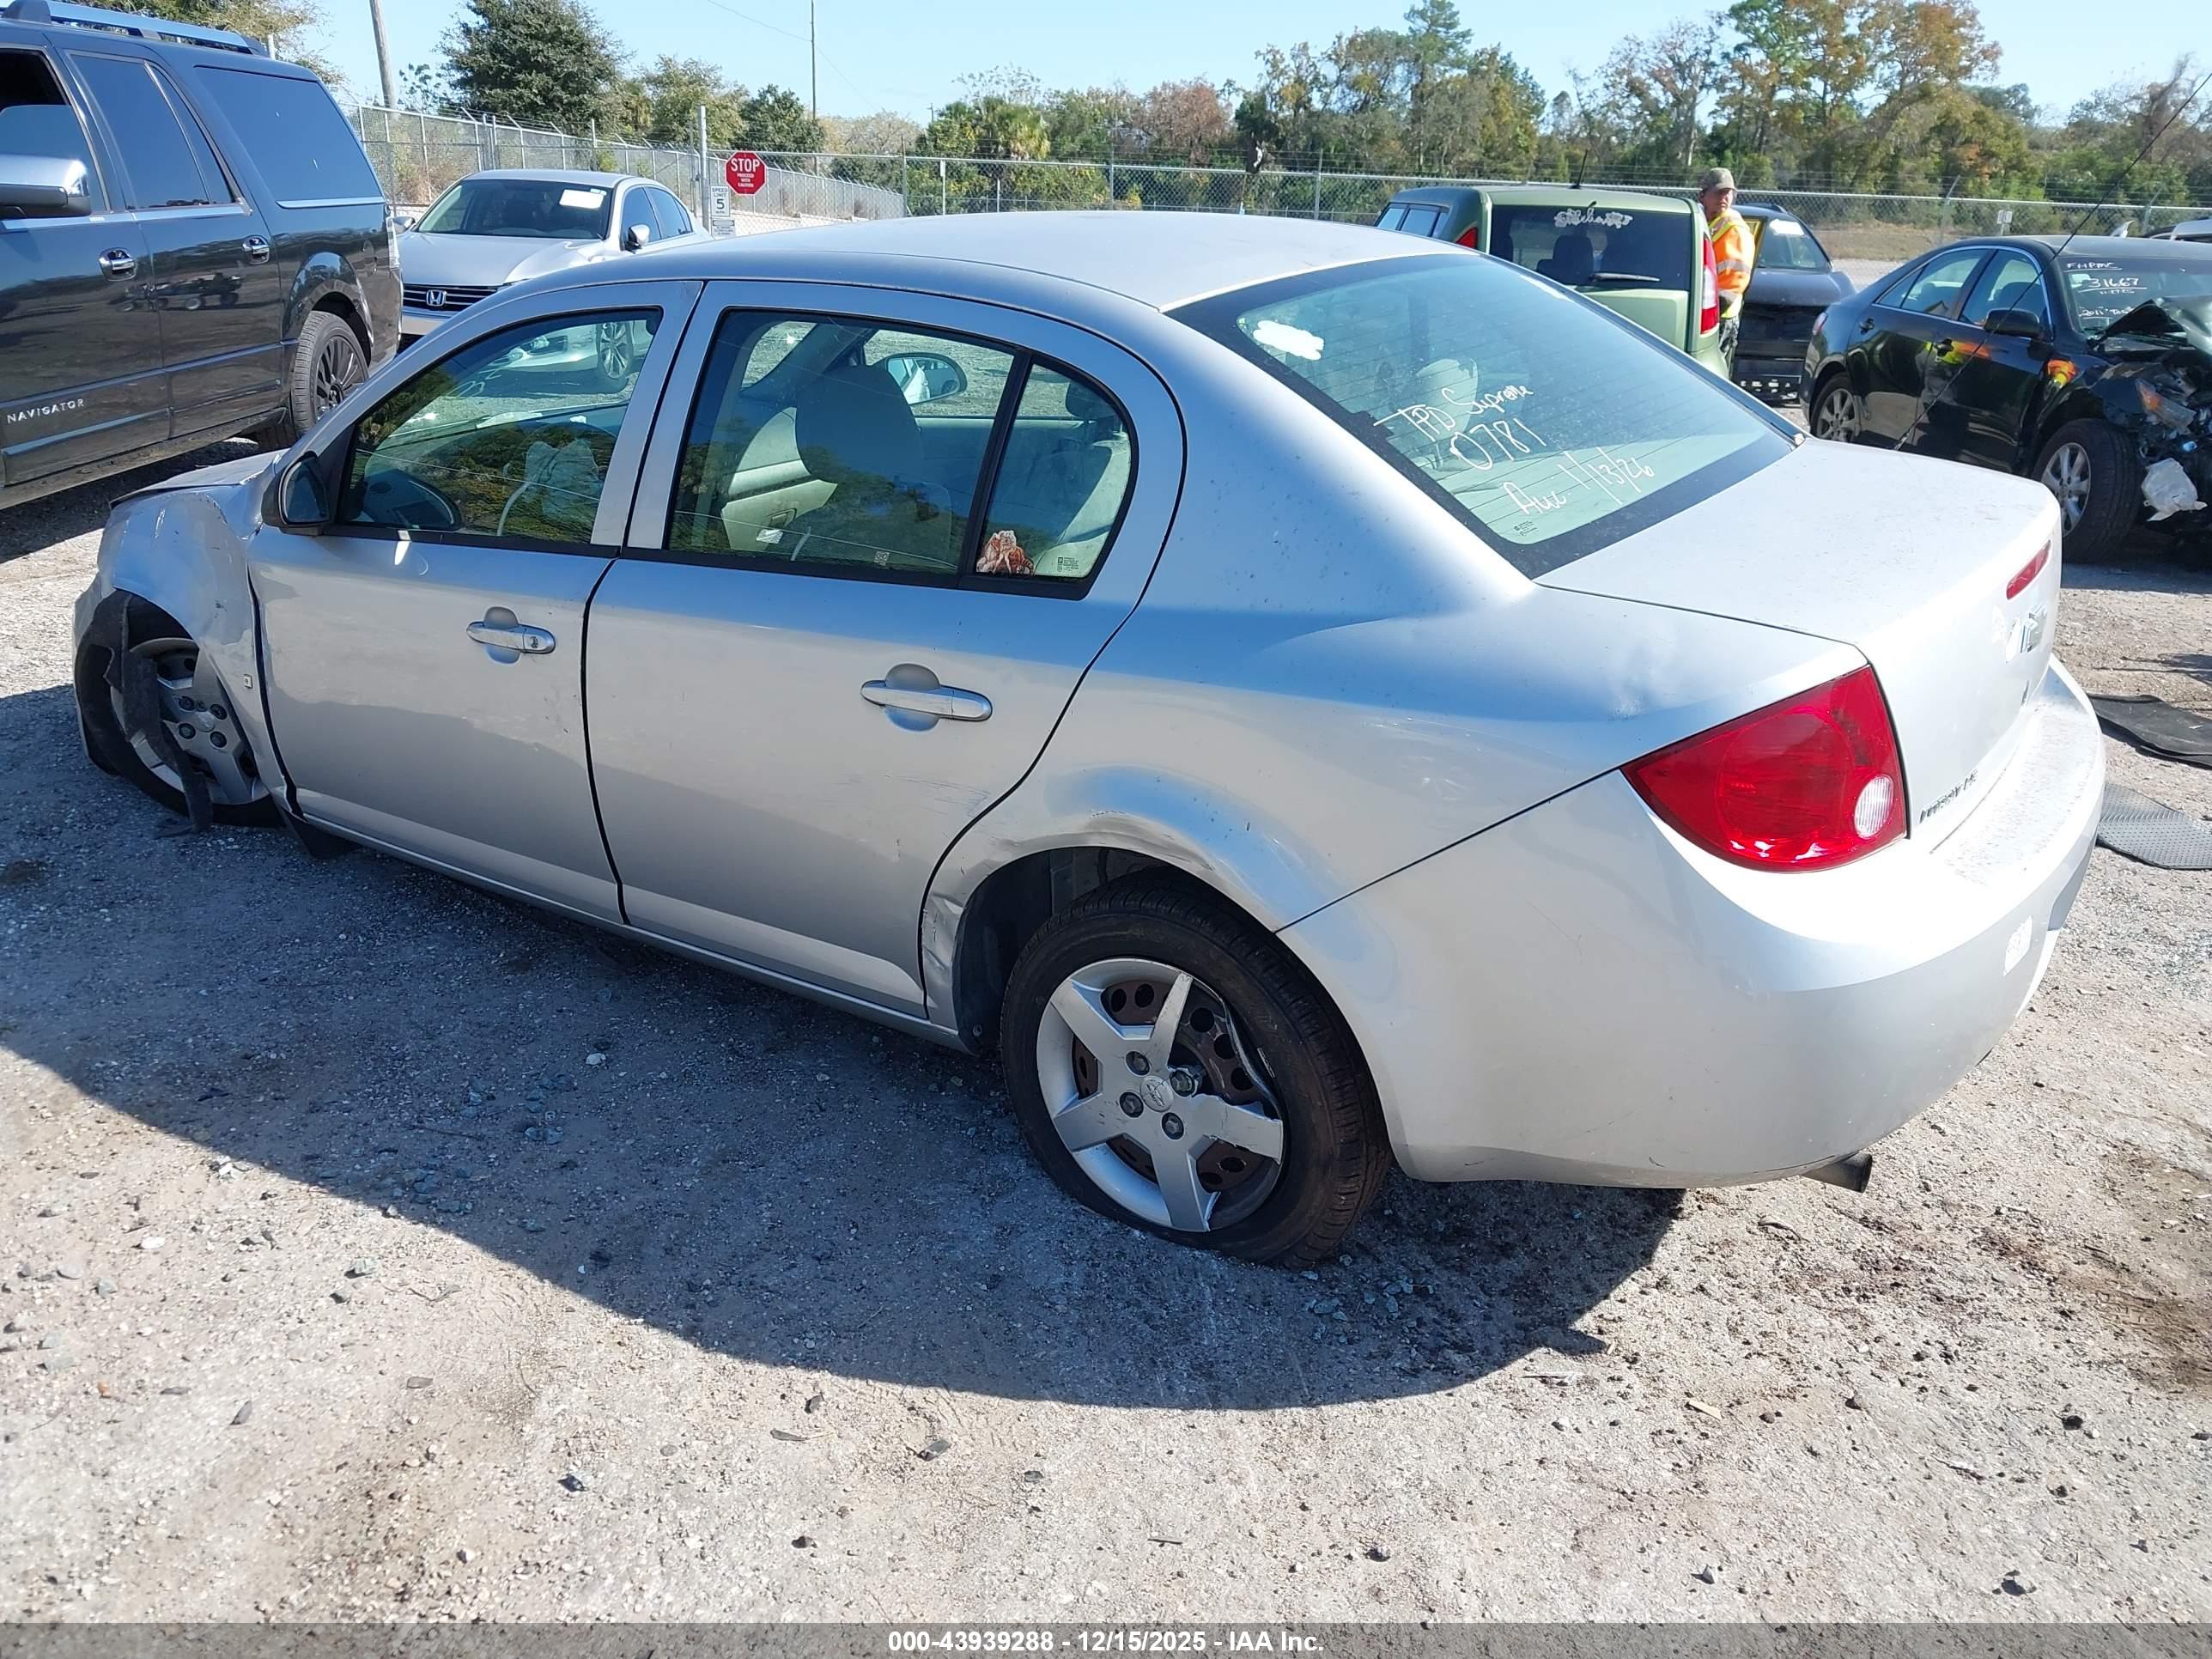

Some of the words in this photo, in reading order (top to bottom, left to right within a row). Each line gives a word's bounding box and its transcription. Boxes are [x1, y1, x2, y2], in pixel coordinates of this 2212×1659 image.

[731, 158, 760, 172] STOP
[716, 198, 725, 210] 5
[7, 398, 84, 424] NAVIGATOR
[1373, 404, 1456, 442] TPD
[1441, 385, 1534, 415] Supreme
[1449, 417, 1547, 471] 0781
[1556, 446, 1656, 506] 1/13/26
